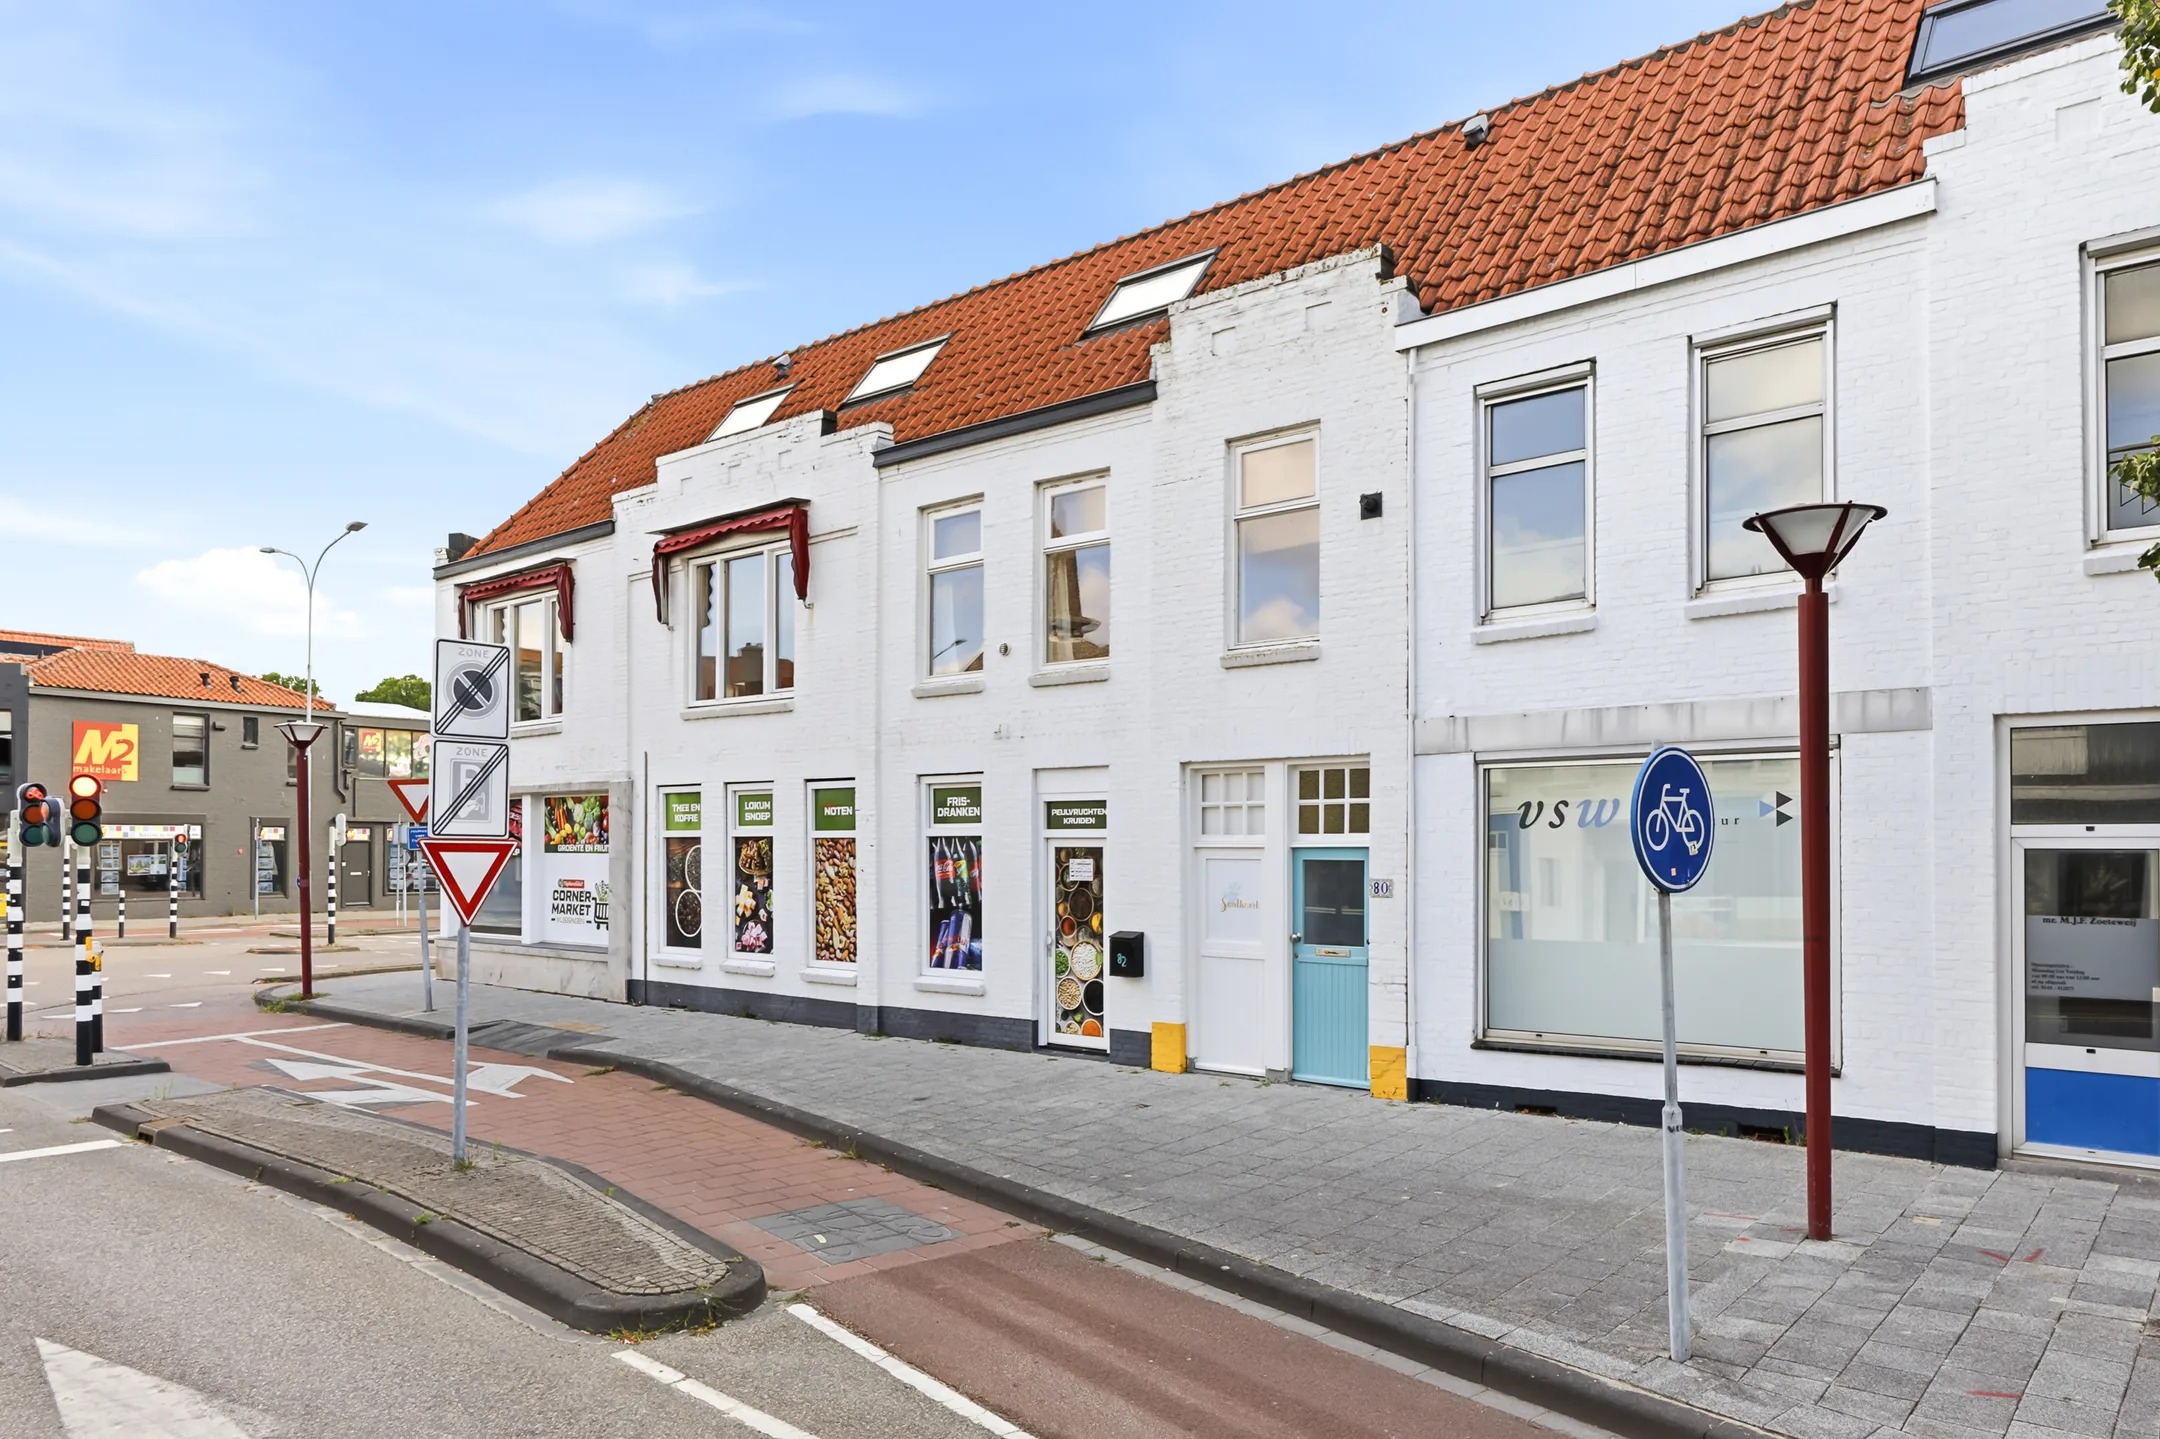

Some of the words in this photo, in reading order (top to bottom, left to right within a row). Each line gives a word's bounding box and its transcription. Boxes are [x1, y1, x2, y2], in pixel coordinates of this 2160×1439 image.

[458, 647, 490, 658] ZONE
[74, 729, 134, 765] M2
[456, 746, 488, 757] ZONE
[745, 802, 771, 810] LOKUM
[947, 797, 971, 806] FRIS-
[672, 804, 689, 812] THEE
[824, 807, 853, 816] NOTEN
[937, 807, 980, 817] DRANKEN
[1052, 808, 1108, 816] PEULVRUCHTEN
[675, 814, 699, 822] KOFFIE
[745, 812, 771, 821] SNOEP
[1373, 881, 1389, 894] 80
[552, 889, 592, 902] CORNER
[551, 902, 592, 916] MARKET
[1117, 953, 1127, 967] 82
